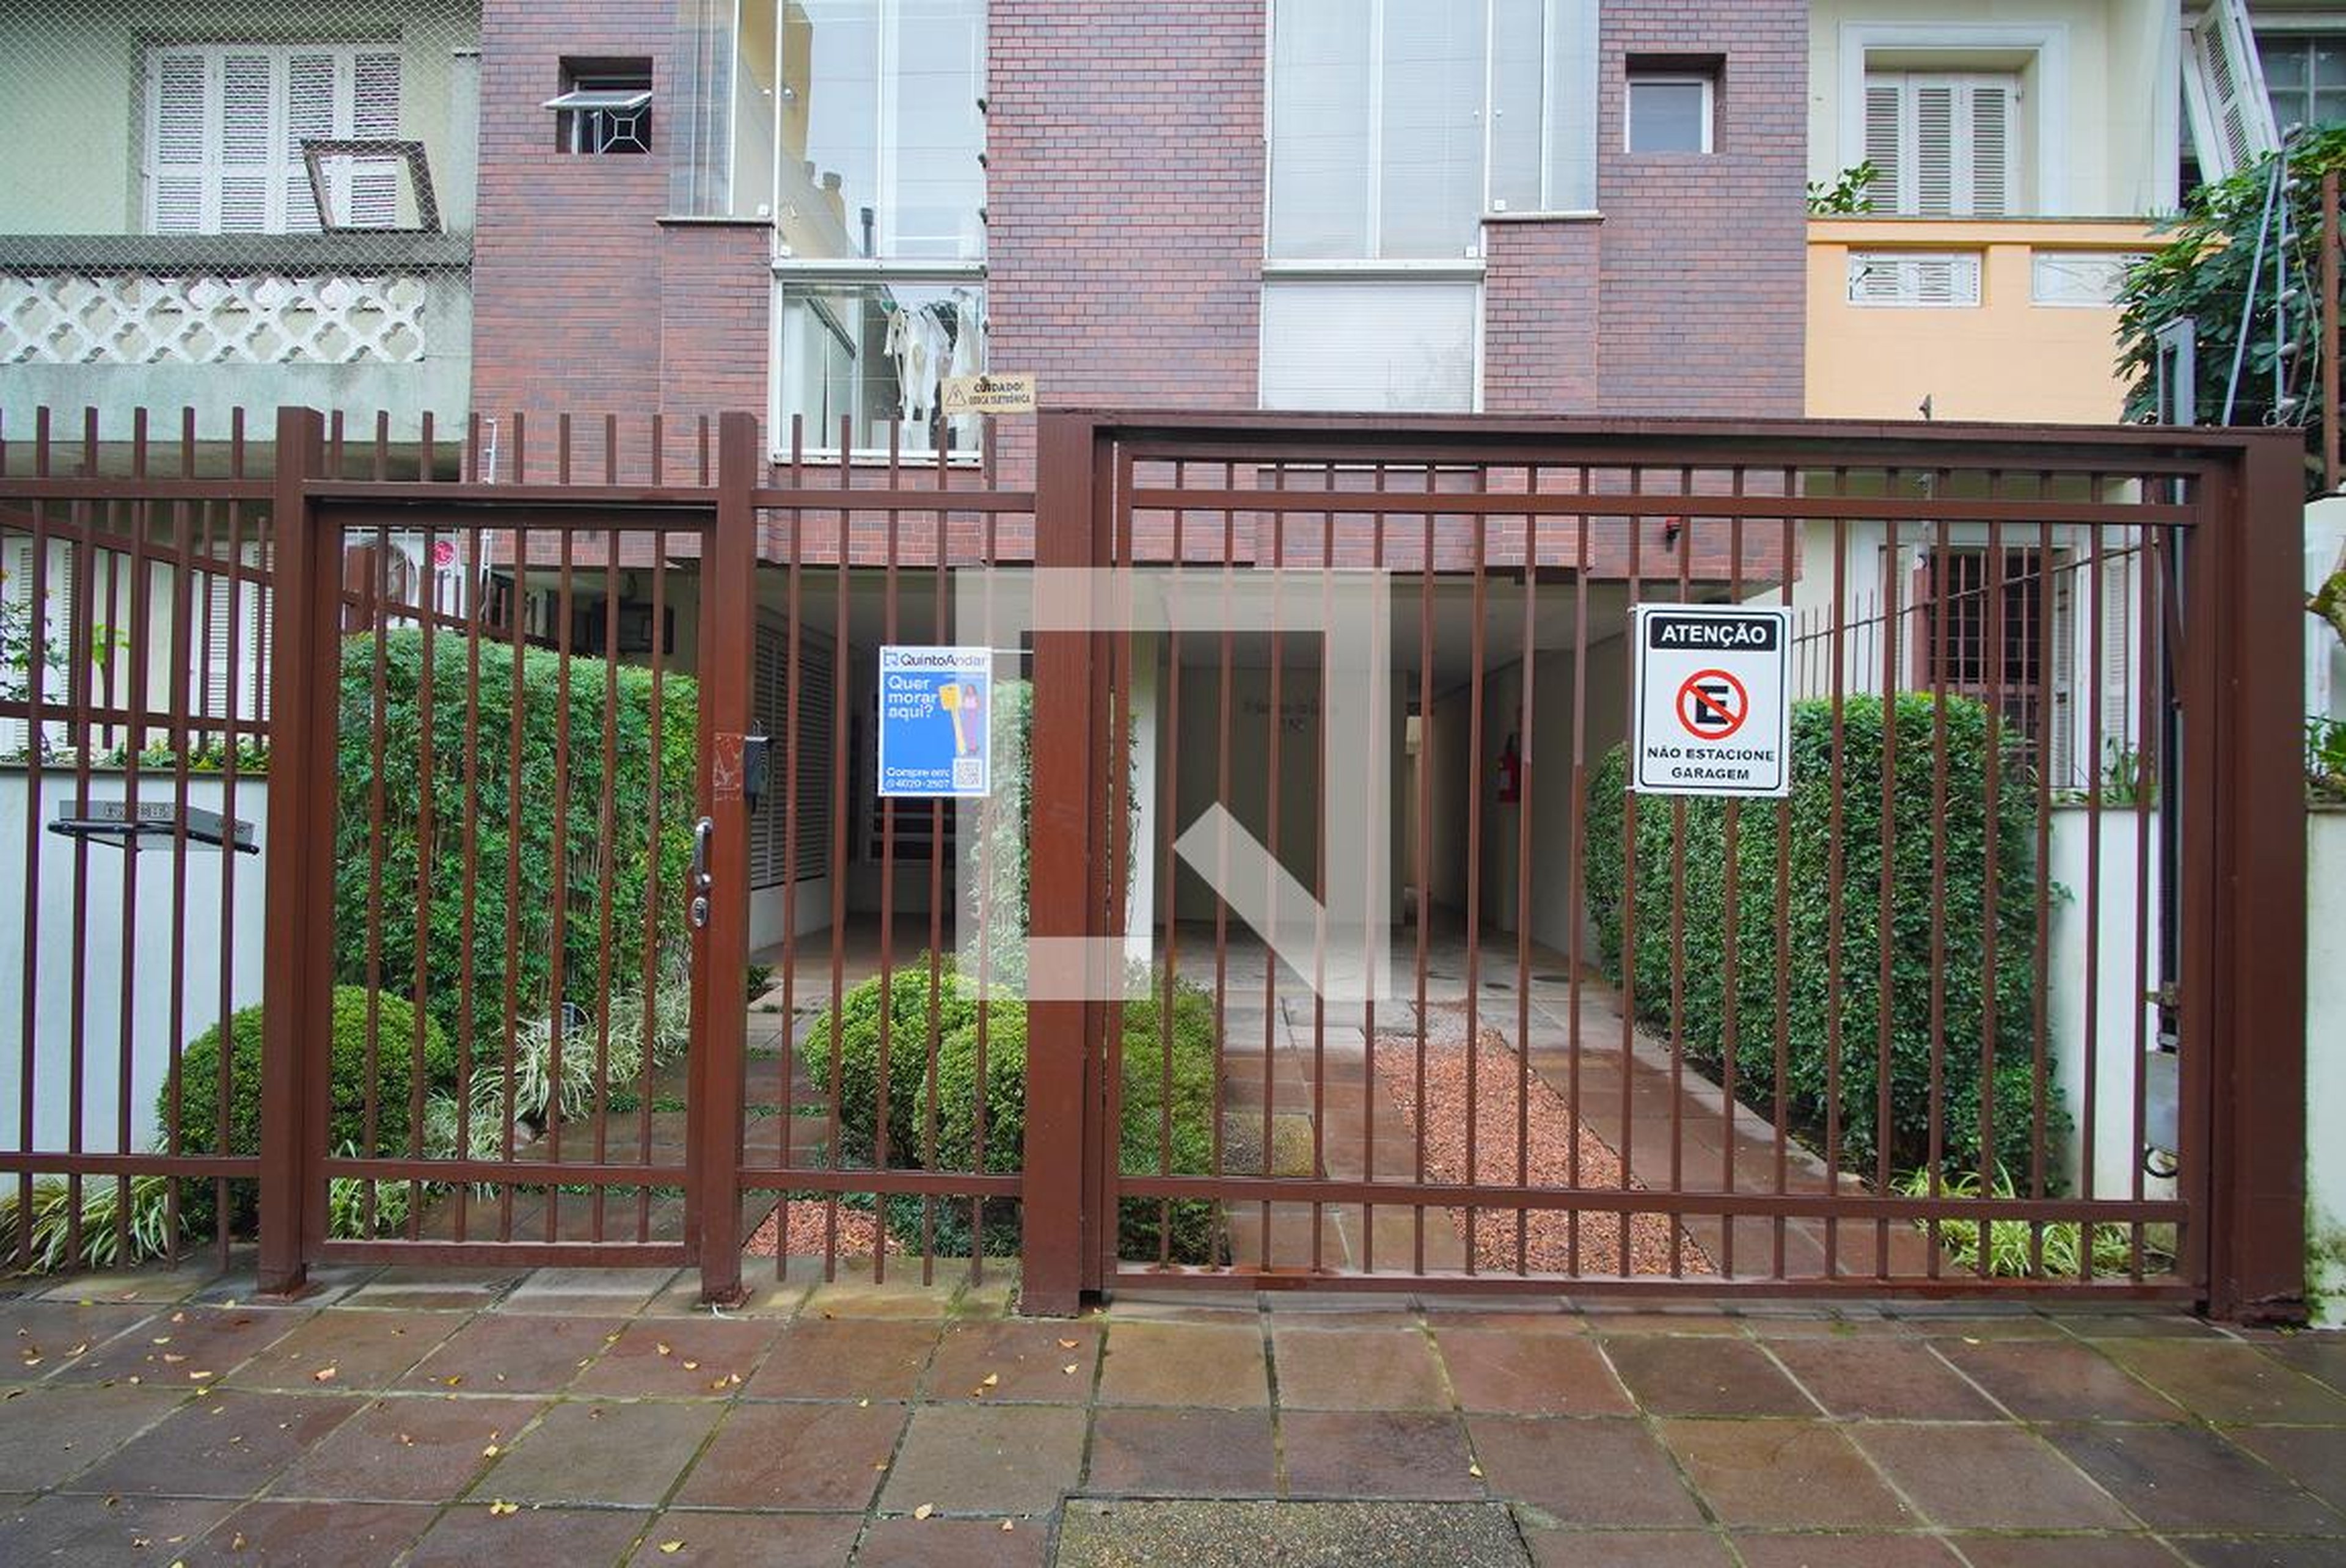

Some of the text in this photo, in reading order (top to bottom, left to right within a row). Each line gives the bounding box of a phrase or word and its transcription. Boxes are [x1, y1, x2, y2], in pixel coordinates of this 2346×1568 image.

[1661, 622, 1767, 647] ATENÇÃO
[900, 652, 986, 667] QuintoAndar
[888, 674, 931, 690] Quer
[888, 693, 938, 704] morar
[888, 704, 934, 721] aqui?
[1647, 746, 1775, 762] NÃO ESTACIONE
[1671, 766, 1750, 780] GARAGEM
